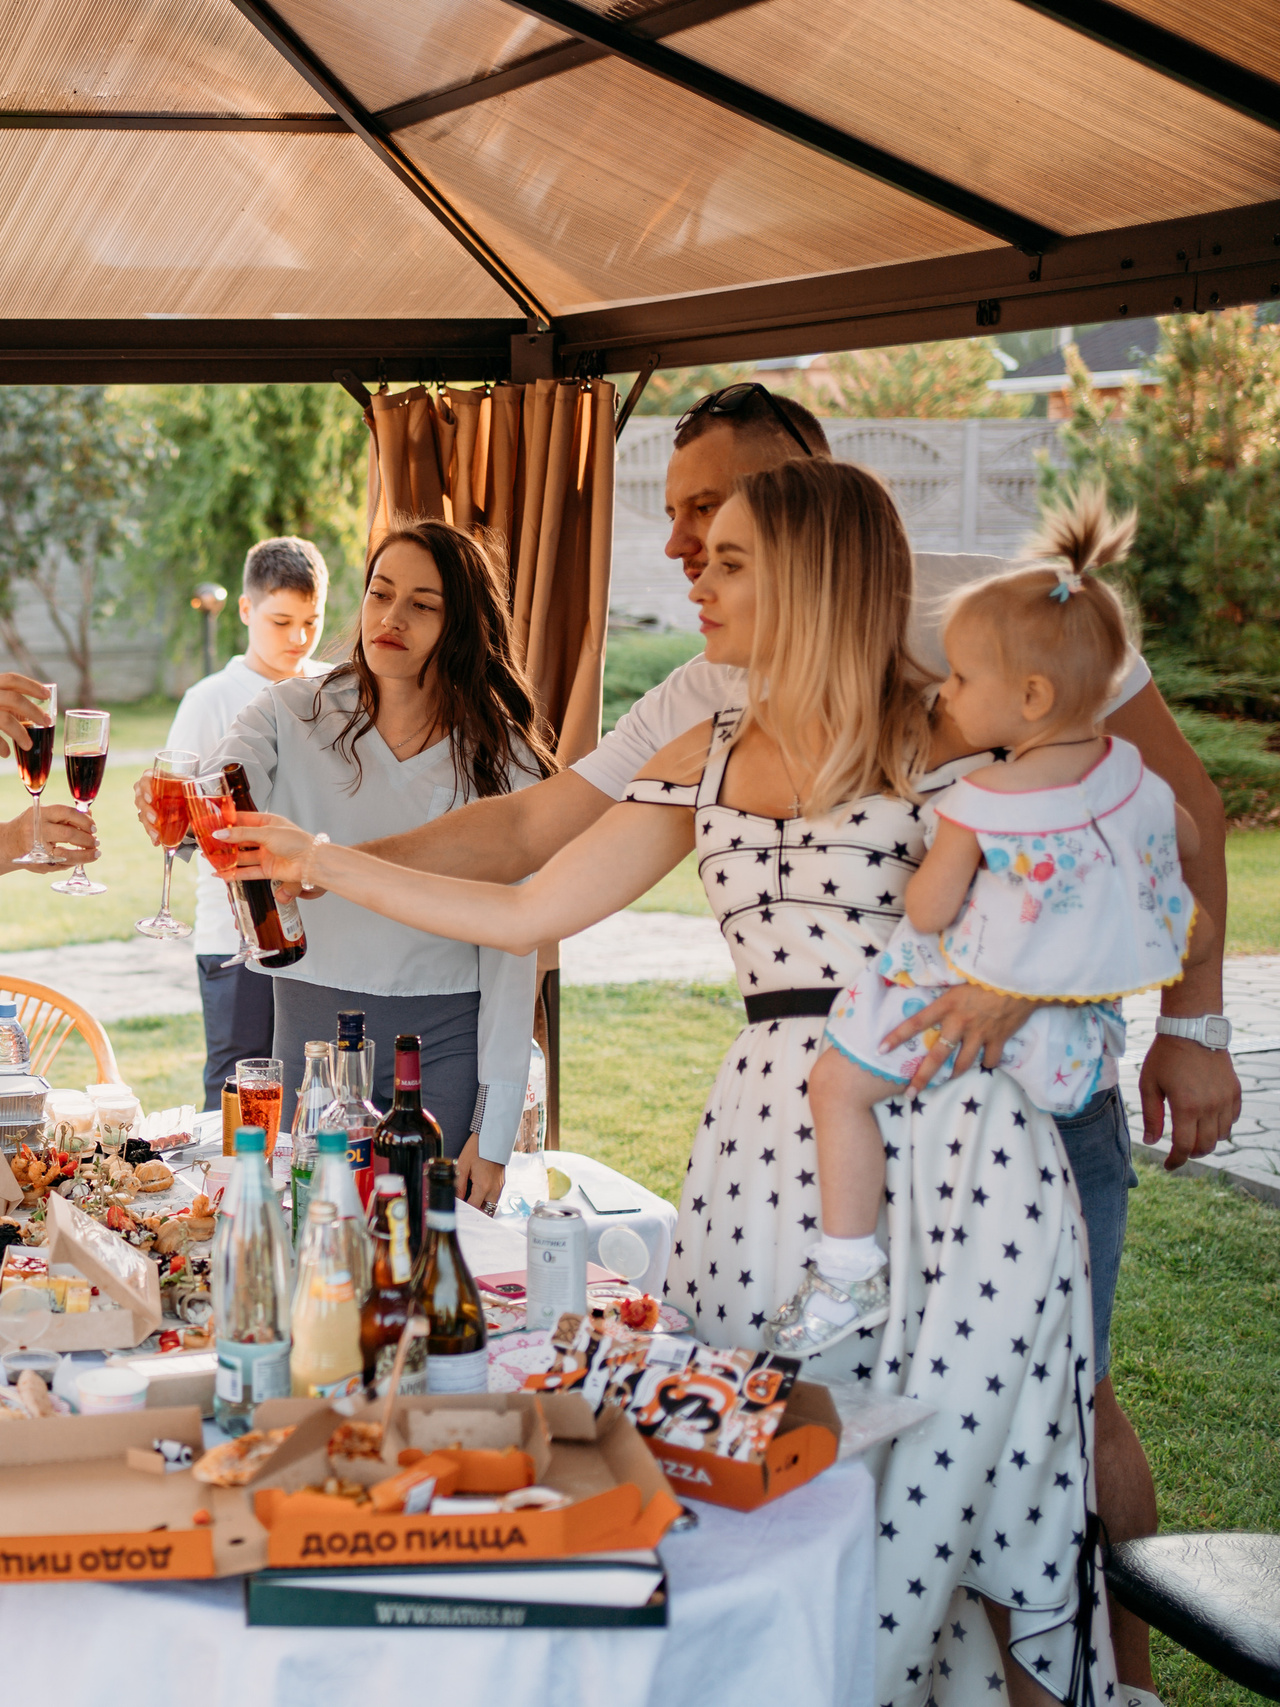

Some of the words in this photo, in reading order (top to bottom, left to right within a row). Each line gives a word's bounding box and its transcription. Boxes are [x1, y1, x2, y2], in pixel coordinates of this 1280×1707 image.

[657, 1459, 713, 1487] IZZA
[301, 1530, 397, 1557] ДОДО
[405, 1526, 528, 1552] ПИЦЦА
[78, 1544, 173, 1573] ДОДО
